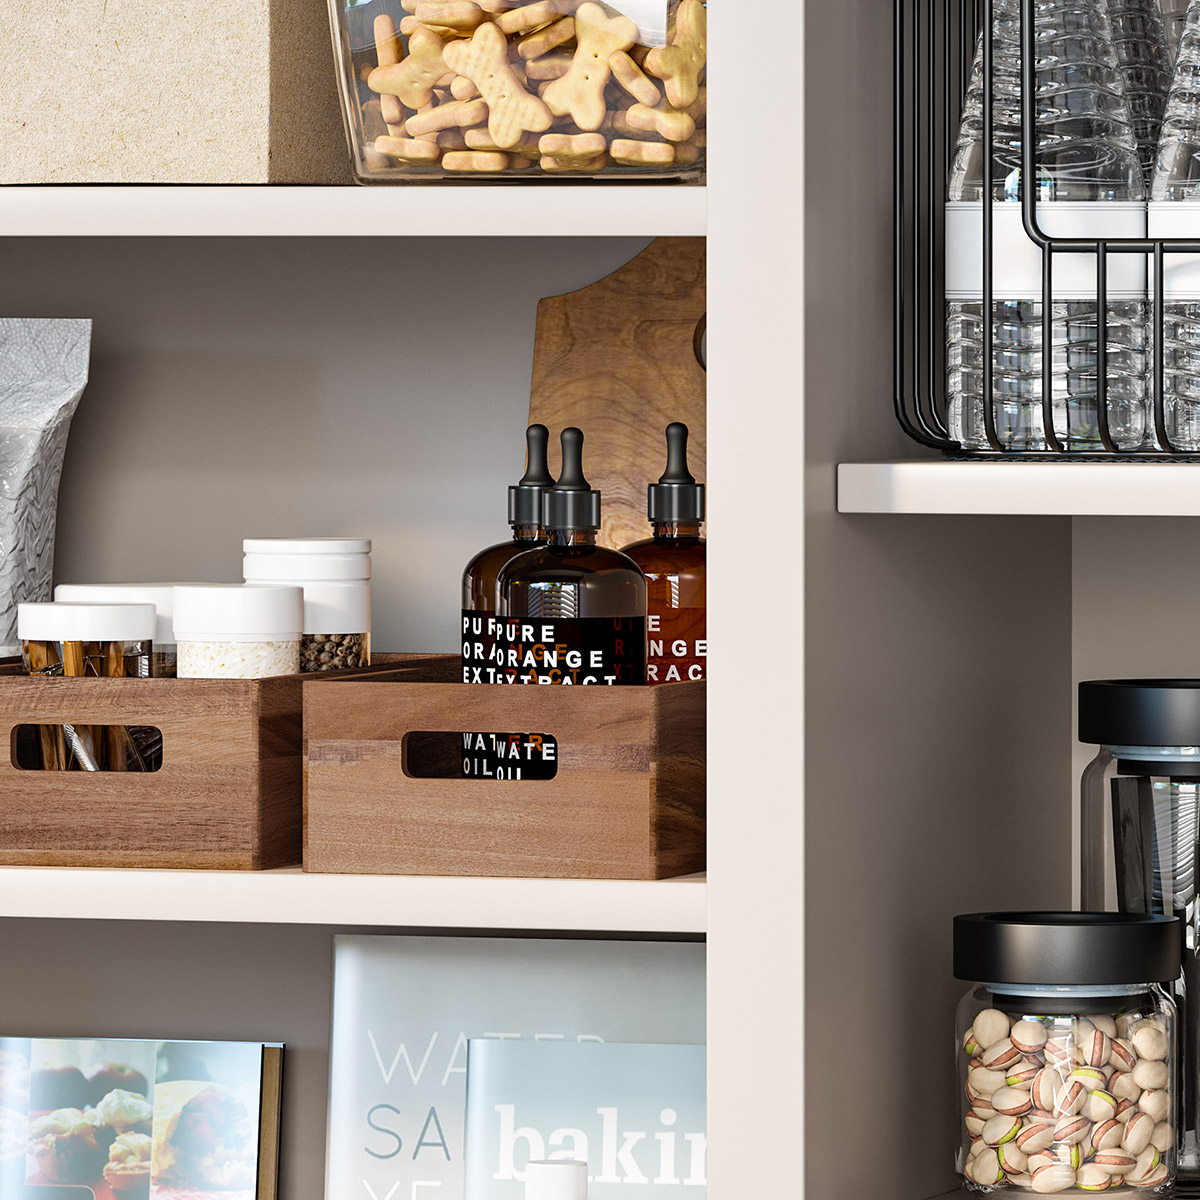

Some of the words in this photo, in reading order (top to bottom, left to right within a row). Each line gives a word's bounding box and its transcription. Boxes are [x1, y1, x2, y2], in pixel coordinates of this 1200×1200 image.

[496, 623, 555, 643] PURE
[496, 648, 603, 668] ORANGE
[496, 741, 556, 760] WATE
[463, 756, 493, 776] OIL
